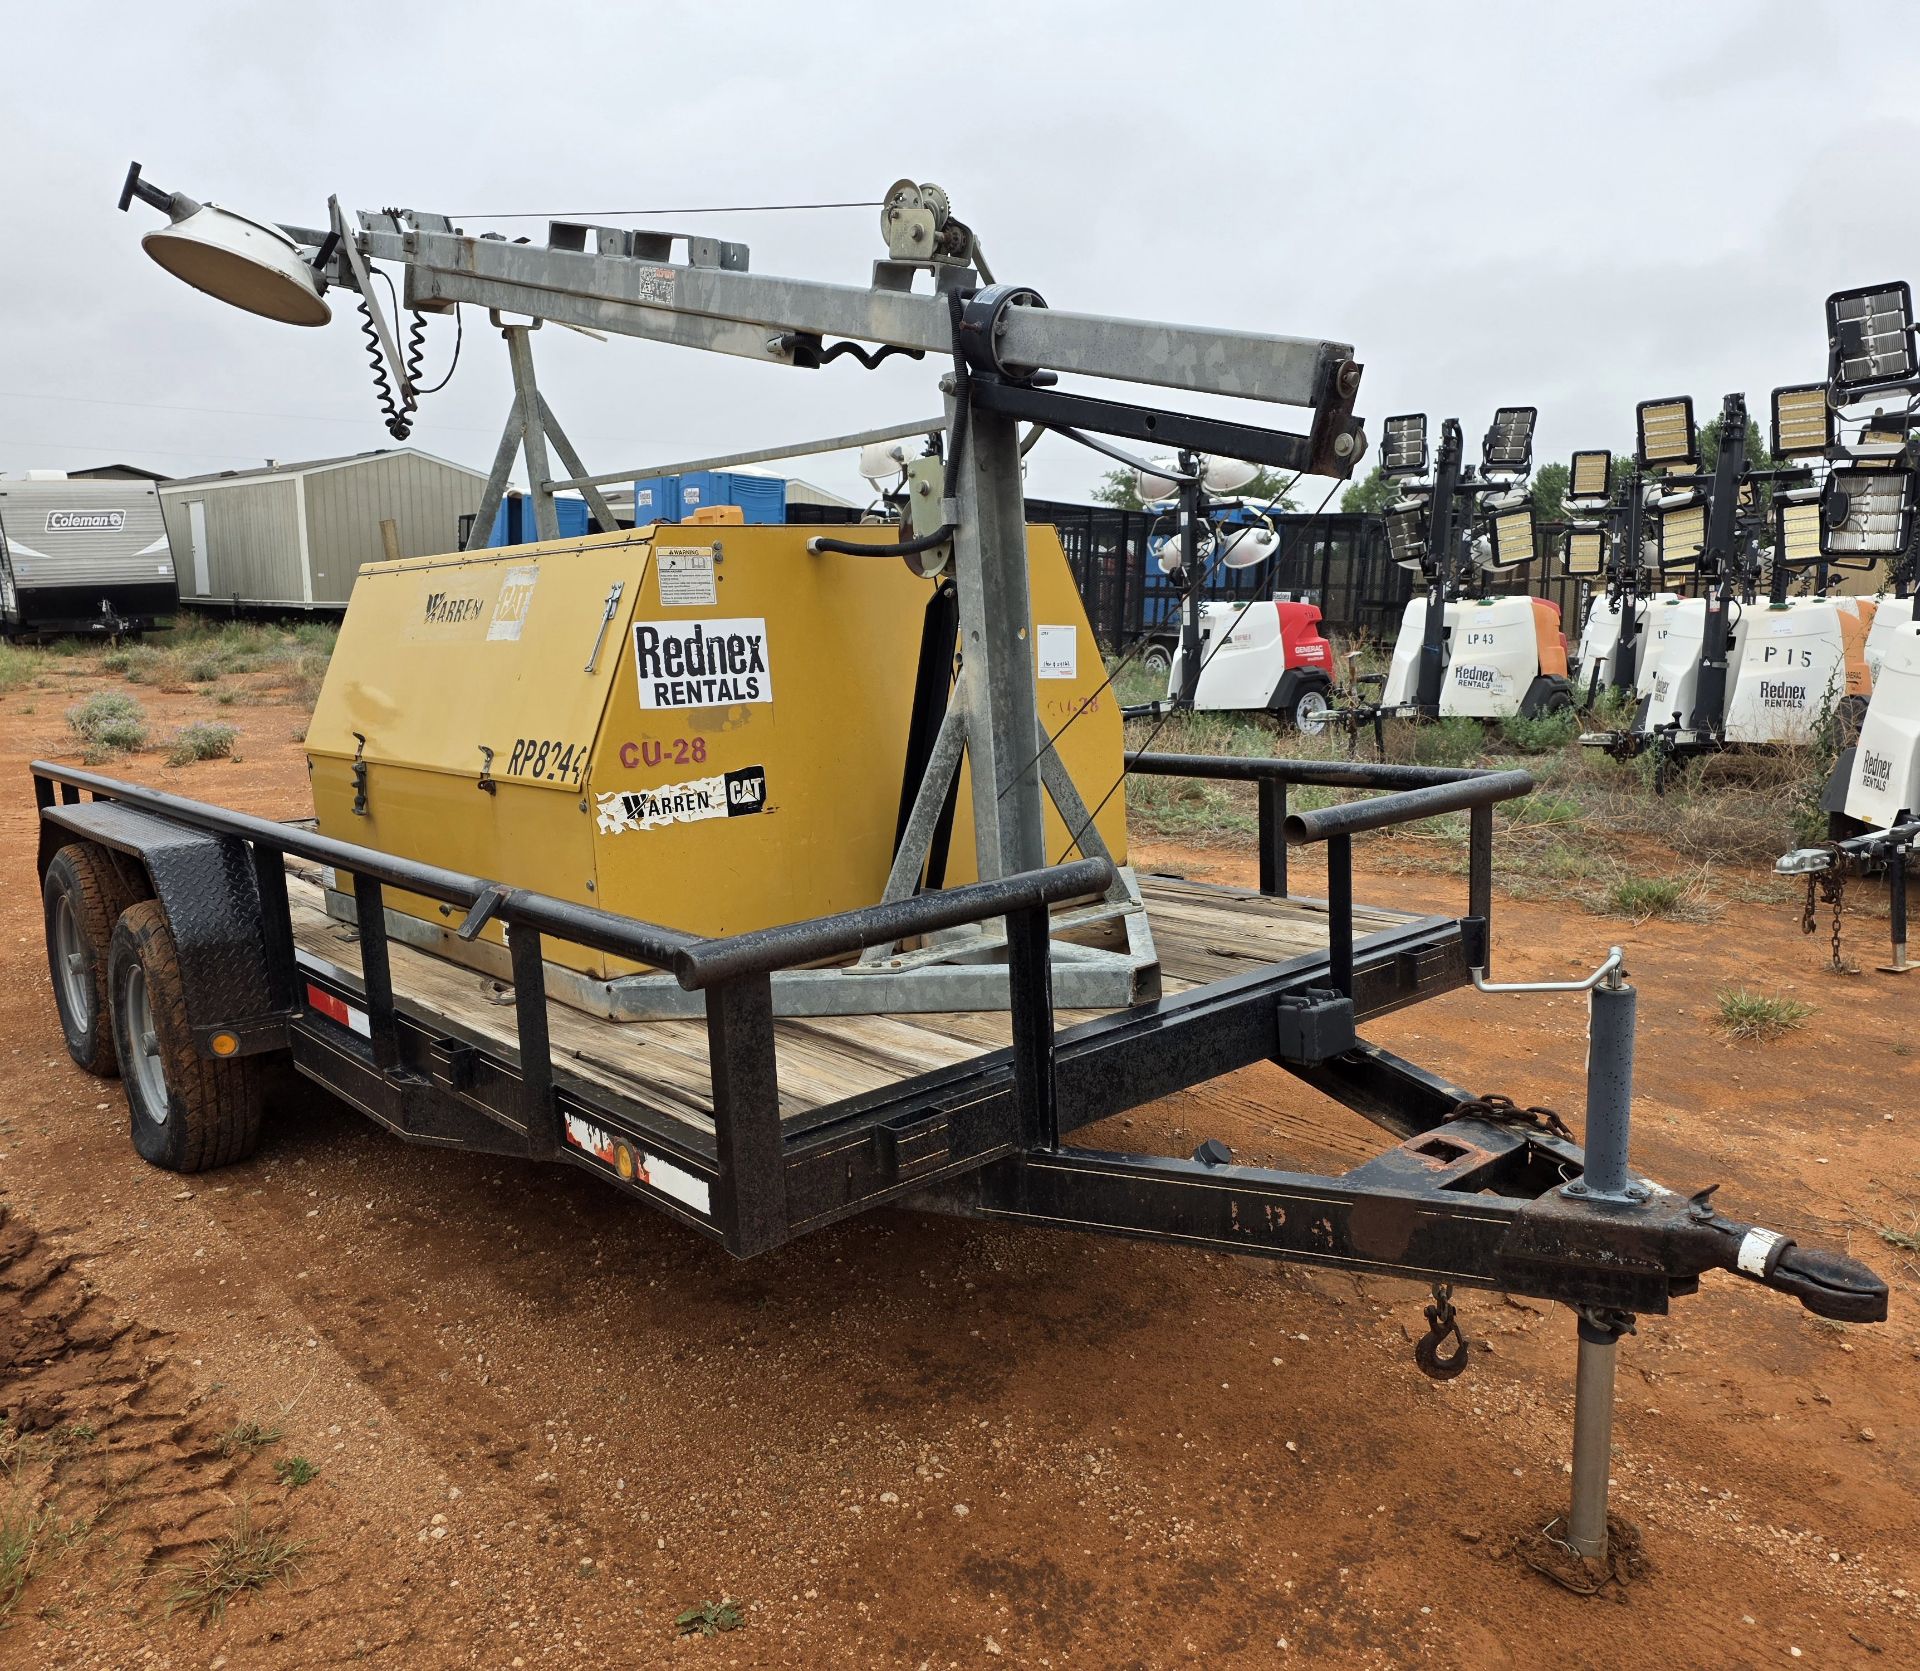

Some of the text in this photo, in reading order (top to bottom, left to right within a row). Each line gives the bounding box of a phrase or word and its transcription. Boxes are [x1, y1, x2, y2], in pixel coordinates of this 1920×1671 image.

[51, 513, 108, 527] Coleman
[1468, 634, 1494, 645] LP 43
[1658, 631, 1668, 639] LP
[636, 624, 765, 679] Rednex
[1295, 645, 1323, 654] GENERAC
[1455, 666, 1494, 682] Rednex
[654, 677, 760, 706] RENTALS
[1458, 680, 1491, 689] RENTALS
[1760, 681, 1806, 700] Rednex
[1764, 699, 1803, 708] RENTALS
[620, 737, 706, 768] CU-28
[1863, 750, 1892, 781] Rednex
[1863, 775, 1887, 792] RENTALS
[622, 777, 763, 819] WARREN CAT
